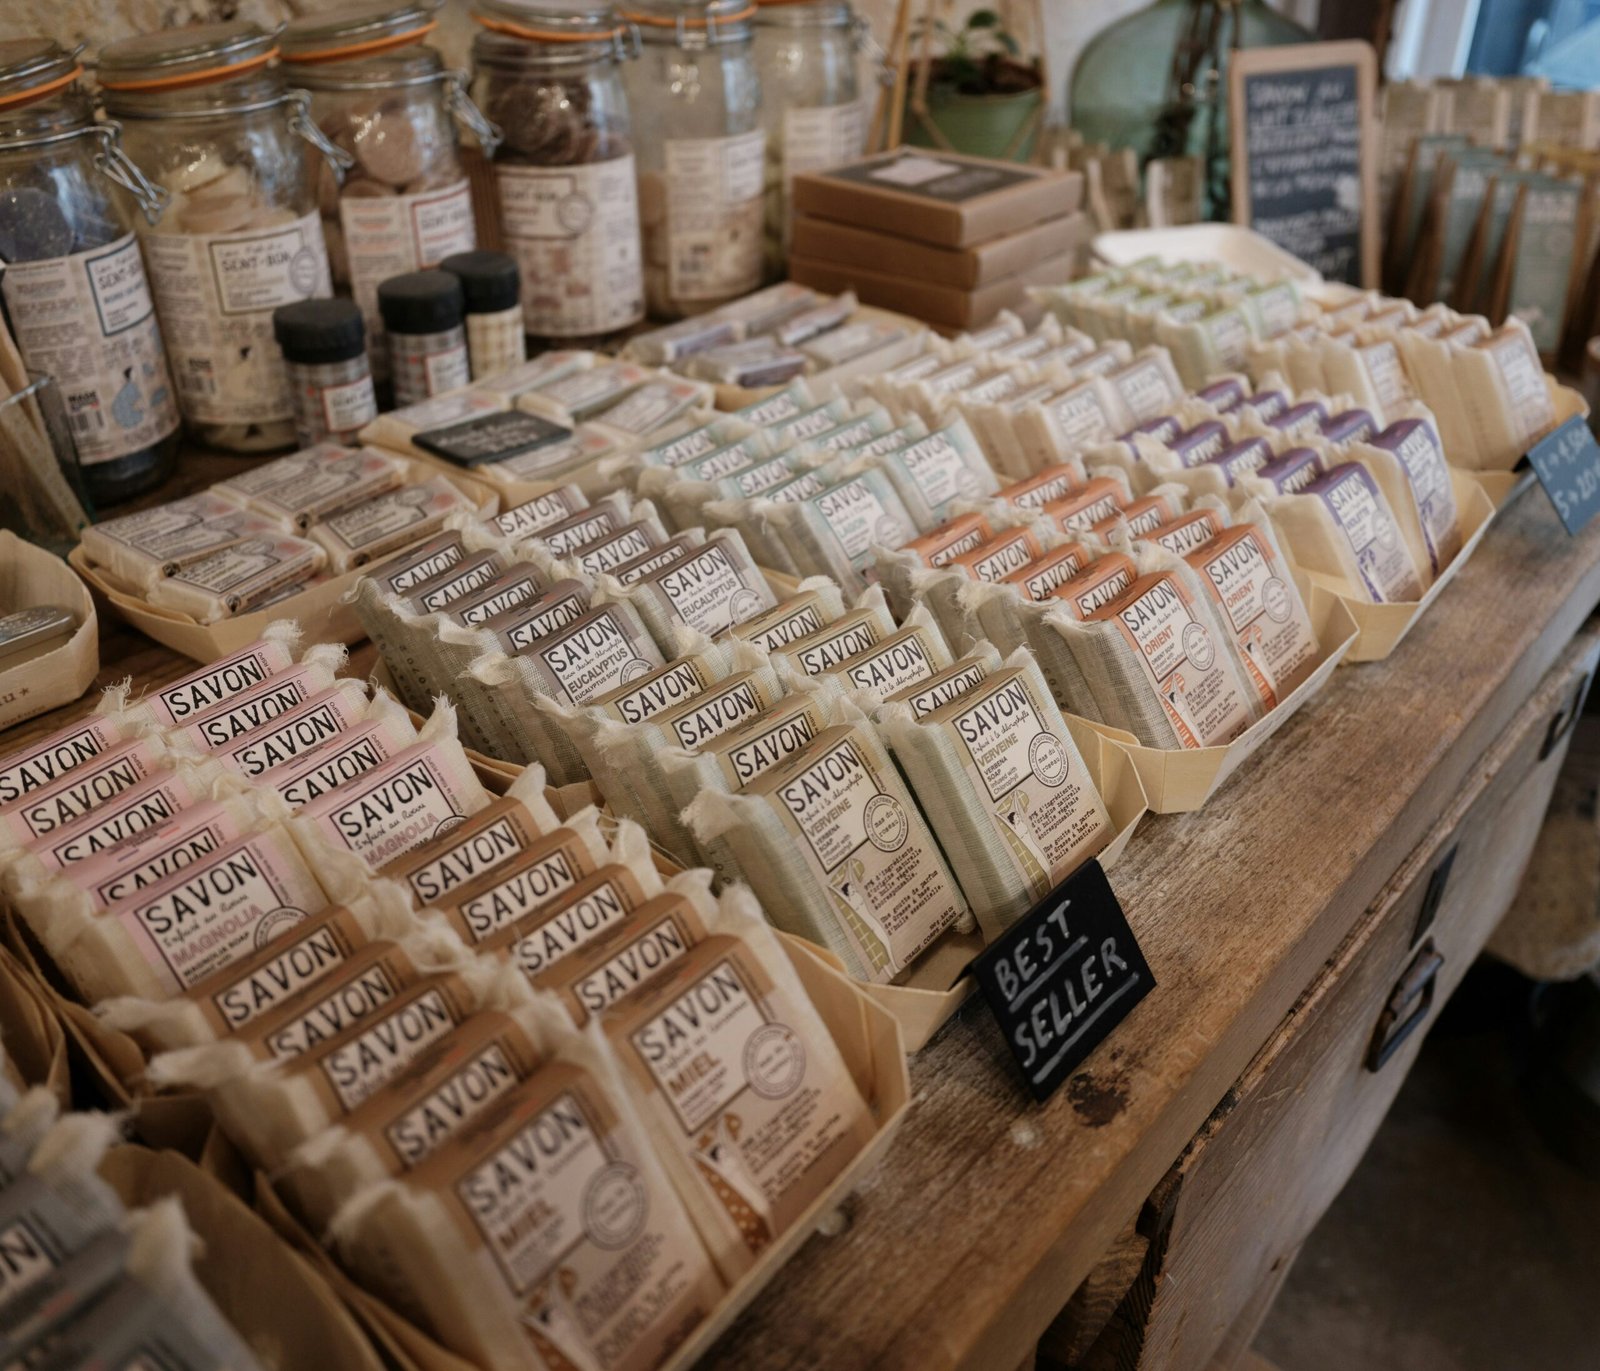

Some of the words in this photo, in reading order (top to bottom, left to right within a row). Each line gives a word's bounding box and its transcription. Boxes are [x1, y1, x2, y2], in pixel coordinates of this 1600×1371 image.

[664, 429, 713, 466] SAVON
[699, 444, 750, 481] SAVON
[903, 435, 950, 468] SAVON
[739, 456, 792, 496] SAVON
[1328, 470, 1367, 511] SAVON
[500, 493, 563, 534] SAVON
[819, 482, 871, 517] SAVON
[1067, 499, 1117, 534] SAVON
[549, 516, 611, 556] SAVON
[583, 533, 646, 577] SAVON
[934, 533, 983, 568] SAVON
[1162, 518, 1212, 554] SAVON
[395, 548, 462, 591] SAVON
[664, 551, 726, 598] SAVON
[978, 541, 1030, 583] SAVON
[1029, 555, 1079, 602] SAVON
[1210, 541, 1259, 585] SAVON
[427, 566, 494, 609] SAVON
[467, 583, 536, 625] SAVON
[682, 577, 736, 618] EUCALYPTUS
[1080, 572, 1129, 617] SAVON
[1123, 584, 1176, 632] SAVON
[1226, 580, 1255, 608] ORIENT
[514, 600, 581, 648] SAVON
[686, 603, 717, 626] EUCALYPTUS
[717, 596, 728, 608] SOAP
[547, 617, 618, 672] SAVON
[805, 628, 873, 675] SAVON
[1144, 625, 1174, 655] ORIENT
[1150, 650, 1166, 665] ORIENT
[1163, 642, 1176, 653] SOAP
[568, 647, 628, 694] EUCALYPTUS
[575, 675, 607, 700] EUCALYPTUS
[607, 667, 619, 679] SOAP
[855, 640, 923, 689] SAVON
[1017, 673, 1029, 691] RSPO
[169, 661, 262, 716] SAVON
[623, 666, 696, 723] SAVON
[916, 671, 980, 713] SAVON
[207, 688, 299, 747] SAVON
[679, 688, 754, 746] SAVON
[959, 684, 1026, 743] SAVON
[995, 731, 1000, 739] la
[243, 712, 336, 775] SAVON
[736, 721, 810, 778] SAVON
[848, 734, 862, 752] RSPO
[977, 733, 1019, 767] VERVEINE
[1038, 753, 1048, 764] mas
[1048, 749, 1056, 757] du
[0, 736, 99, 801] SAVON
[284, 744, 378, 804] SAVON
[785, 746, 859, 813] SAVON
[984, 756, 1008, 775] VERBENA
[987, 769, 1001, 782] SOAP
[993, 773, 1019, 795] Chlorophyll
[1007, 766, 1017, 778] with
[1042, 757, 1061, 773] roseau
[30, 764, 138, 834] SAVON
[339, 766, 432, 837] SAVON
[806, 798, 851, 837] VERVEINE
[874, 817, 885, 829] mas
[886, 810, 893, 820] du
[1031, 805, 1056, 828] d'origine
[1057, 786, 1080, 807] naturelle
[1042, 814, 1056, 831] huile
[1058, 796, 1079, 815] végétale
[62, 798, 170, 861] SAVON
[363, 812, 439, 865] MAGNOLIA
[814, 825, 840, 847] VERBENA
[818, 838, 834, 853] SOAP
[840, 834, 851, 846] with
[879, 819, 899, 838] roseau
[1043, 844, 1053, 853] Une
[1055, 829, 1070, 846] goutte
[1079, 808, 1096, 824] parfum
[1049, 847, 1069, 865] d'huile
[1070, 822, 1100, 848] essentielle.
[1055, 836, 1070, 852] Grasse
[1077, 822, 1088, 833] base
[417, 823, 516, 900] SAVON
[895, 848, 922, 875] naturelle
[146, 855, 257, 934] SAVON
[468, 857, 570, 931] SAVON
[871, 895, 877, 903] et
[878, 882, 895, 900] huile
[881, 912, 891, 923] Une
[893, 896, 911, 919] goutte
[912, 887, 919, 896] de
[920, 870, 938, 889] parfum
[884, 922, 892, 930] de
[892, 903, 911, 923] Grasse
[918, 886, 930, 899] base
[910, 884, 944, 917] essentielle.
[173, 904, 263, 967] MAGNOLIA
[520, 888, 619, 970] SAVON
[903, 943, 922, 964] VISAGE
[923, 930, 939, 945] CORPS
[942, 911, 957, 927] MAINS
[995, 900, 1071, 1001] BEST
[225, 932, 338, 1022] SAVON
[581, 924, 681, 1012] SAVON
[276, 972, 391, 1055] SAVON
[639, 968, 741, 1062] SAVON
[1014, 937, 1128, 1068] SELLER
[331, 997, 446, 1087] SAVON
[668, 1051, 721, 1096] MIEL
[398, 1056, 510, 1158] SAVON
[466, 1103, 584, 1215] SAVON
[500, 1201, 557, 1249] MIEL
